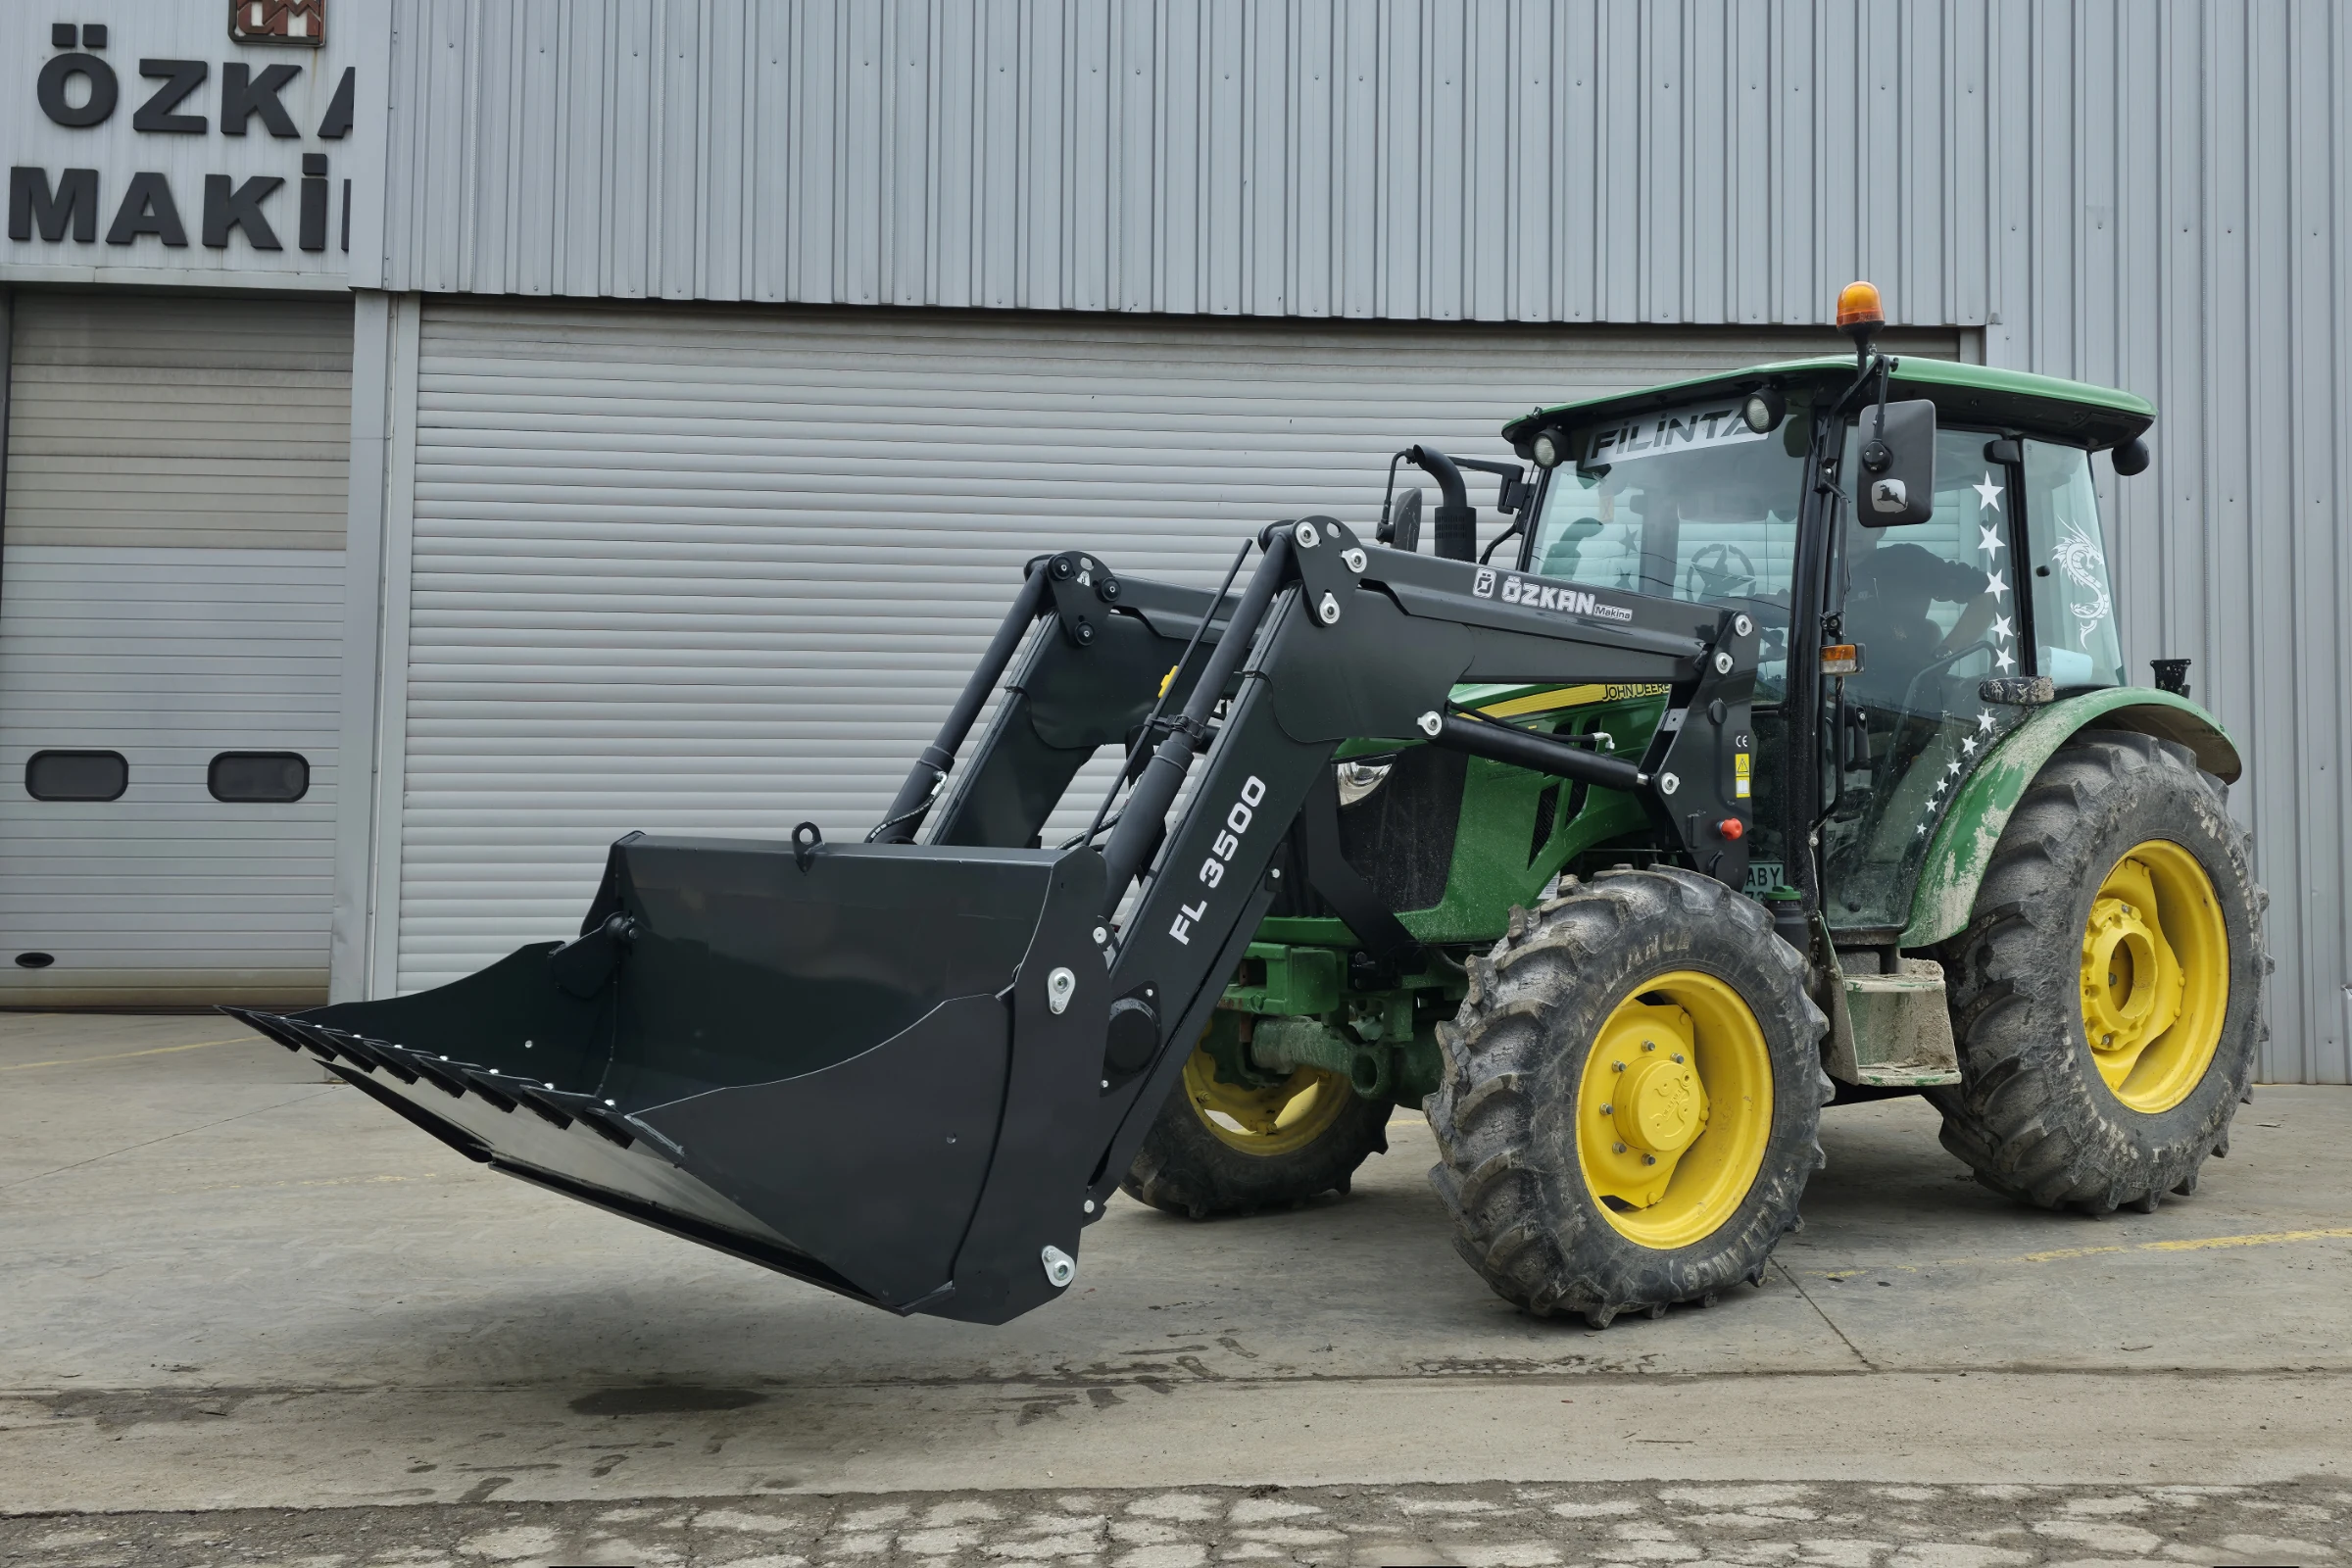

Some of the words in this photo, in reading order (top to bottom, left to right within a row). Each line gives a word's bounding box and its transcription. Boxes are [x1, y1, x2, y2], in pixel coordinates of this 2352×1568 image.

[8, 153, 352, 252] MAKİ
[1501, 575, 1596, 616] ÖZKAN
[1595, 605, 1632, 620] Makina
[1602, 683, 1634, 700] JOHN
[1636, 683, 1671, 696] DEERE
[1736, 735, 1748, 748] CE
[1169, 901, 1207, 946] FL
[1200, 775, 1266, 889] 3500
[1745, 867, 1781, 887] ABY
